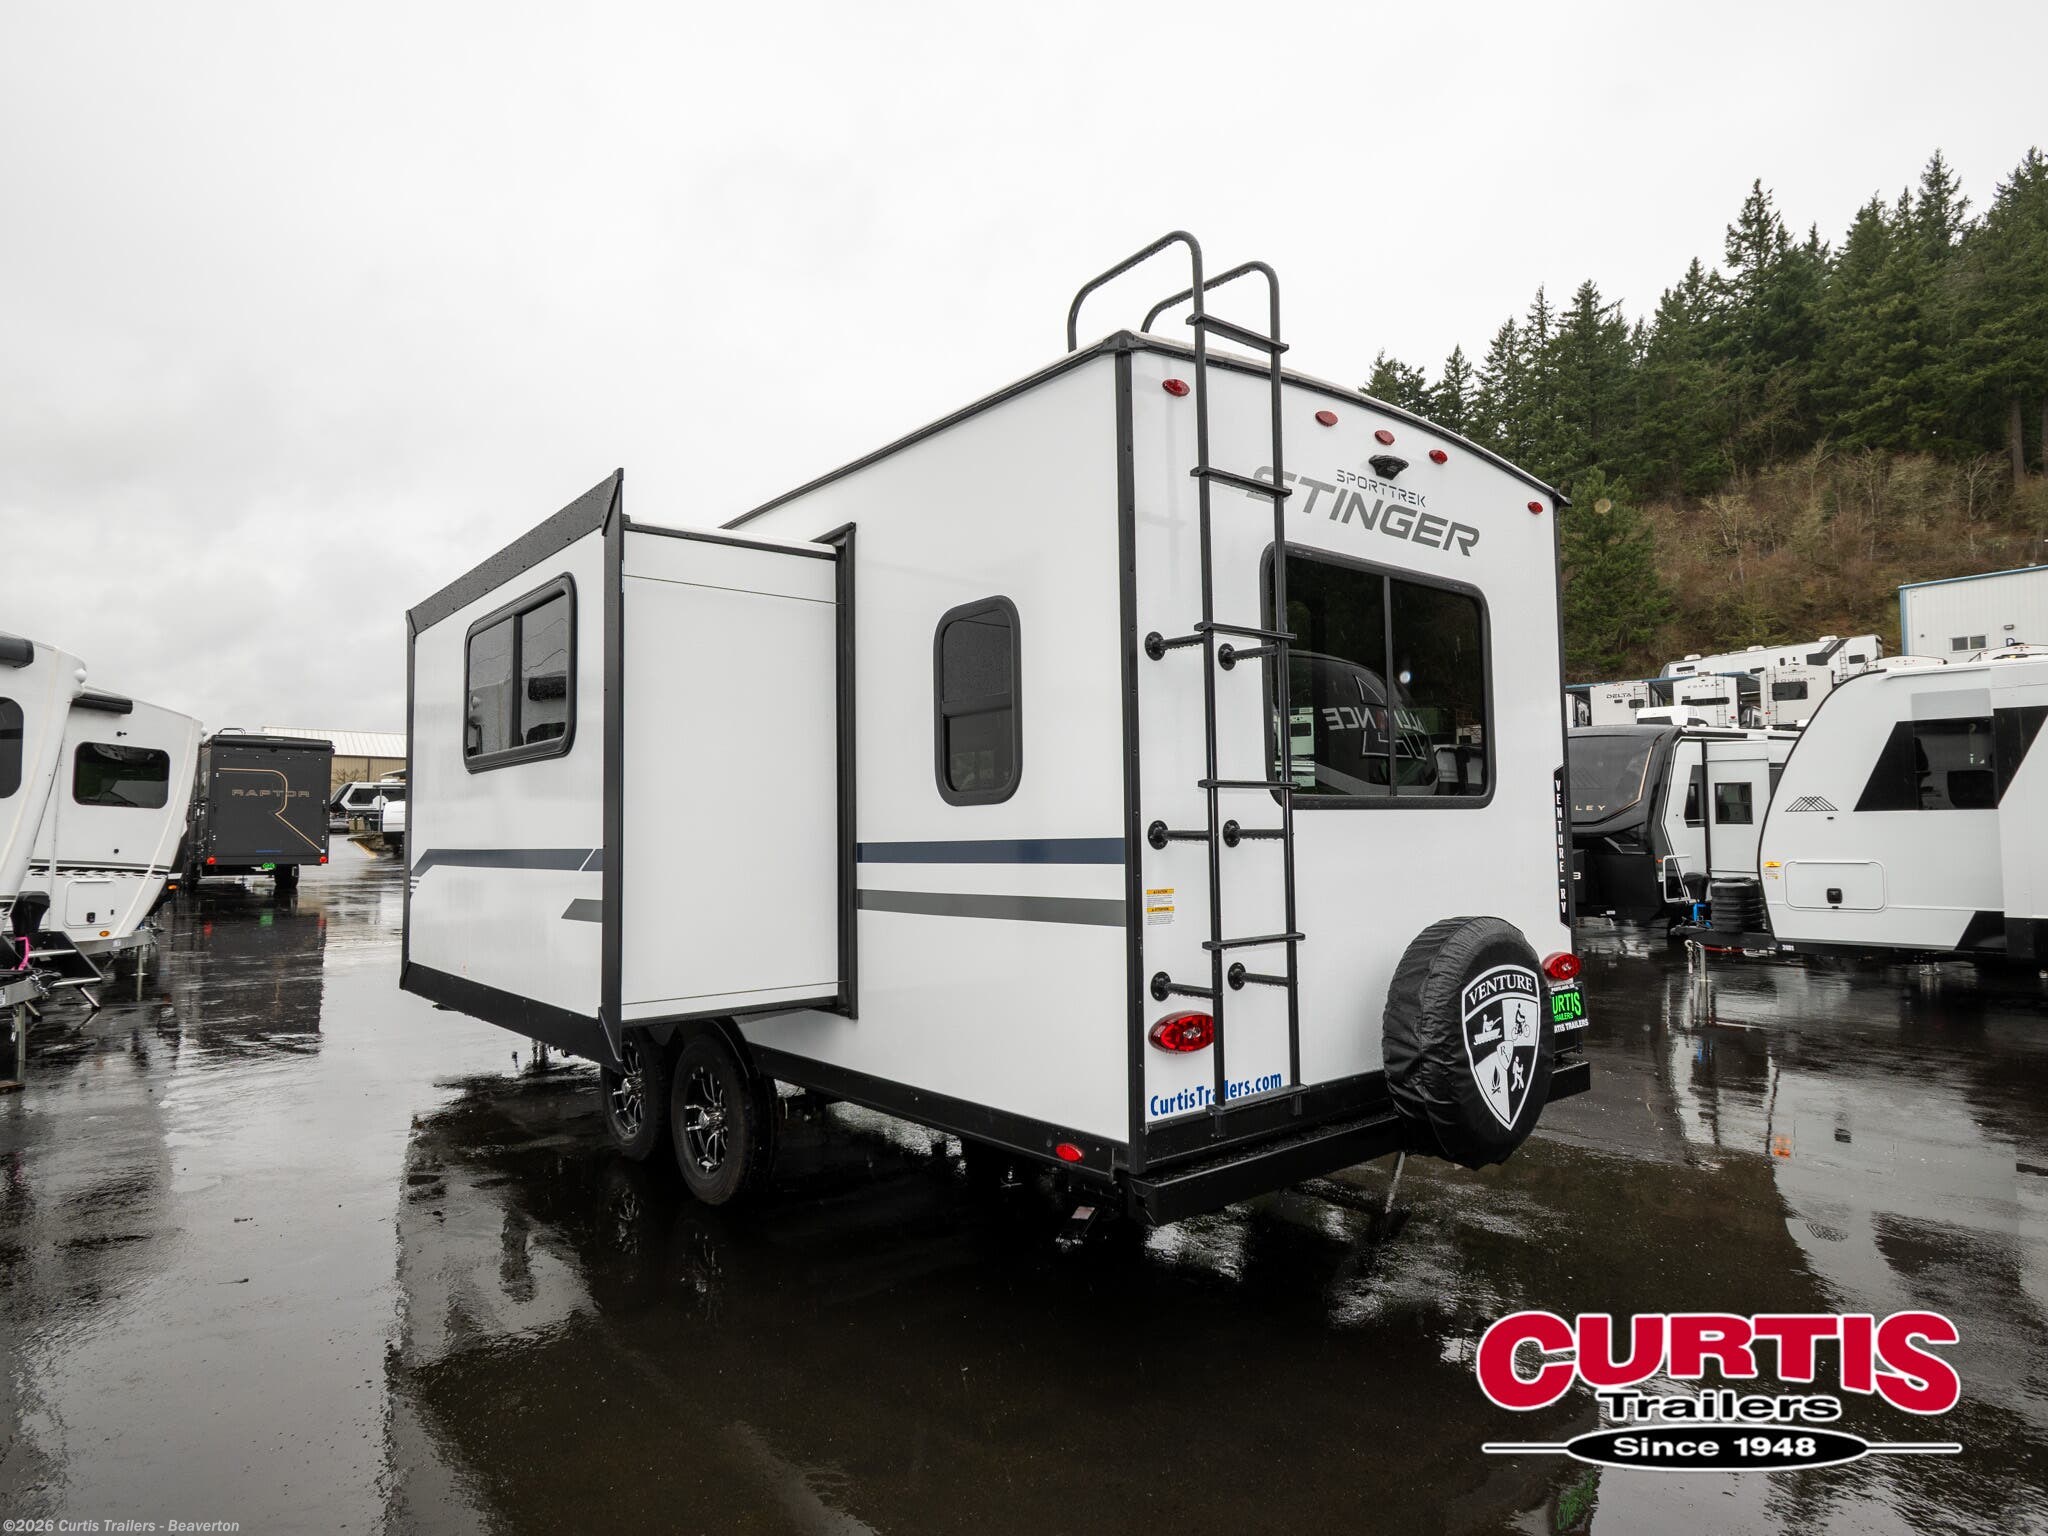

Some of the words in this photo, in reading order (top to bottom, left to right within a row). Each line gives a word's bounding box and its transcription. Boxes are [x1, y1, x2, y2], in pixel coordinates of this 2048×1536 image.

[1336, 469, 1426, 508] SPORTTREK
[1246, 466, 1480, 558] STINGER
[231, 789, 310, 798] RAPTOR
[1468, 974, 1534, 1006] VENTURE
[1552, 992, 1582, 1016] URTIS
[1150, 1073, 1282, 1116] CurtisTrlers.com
